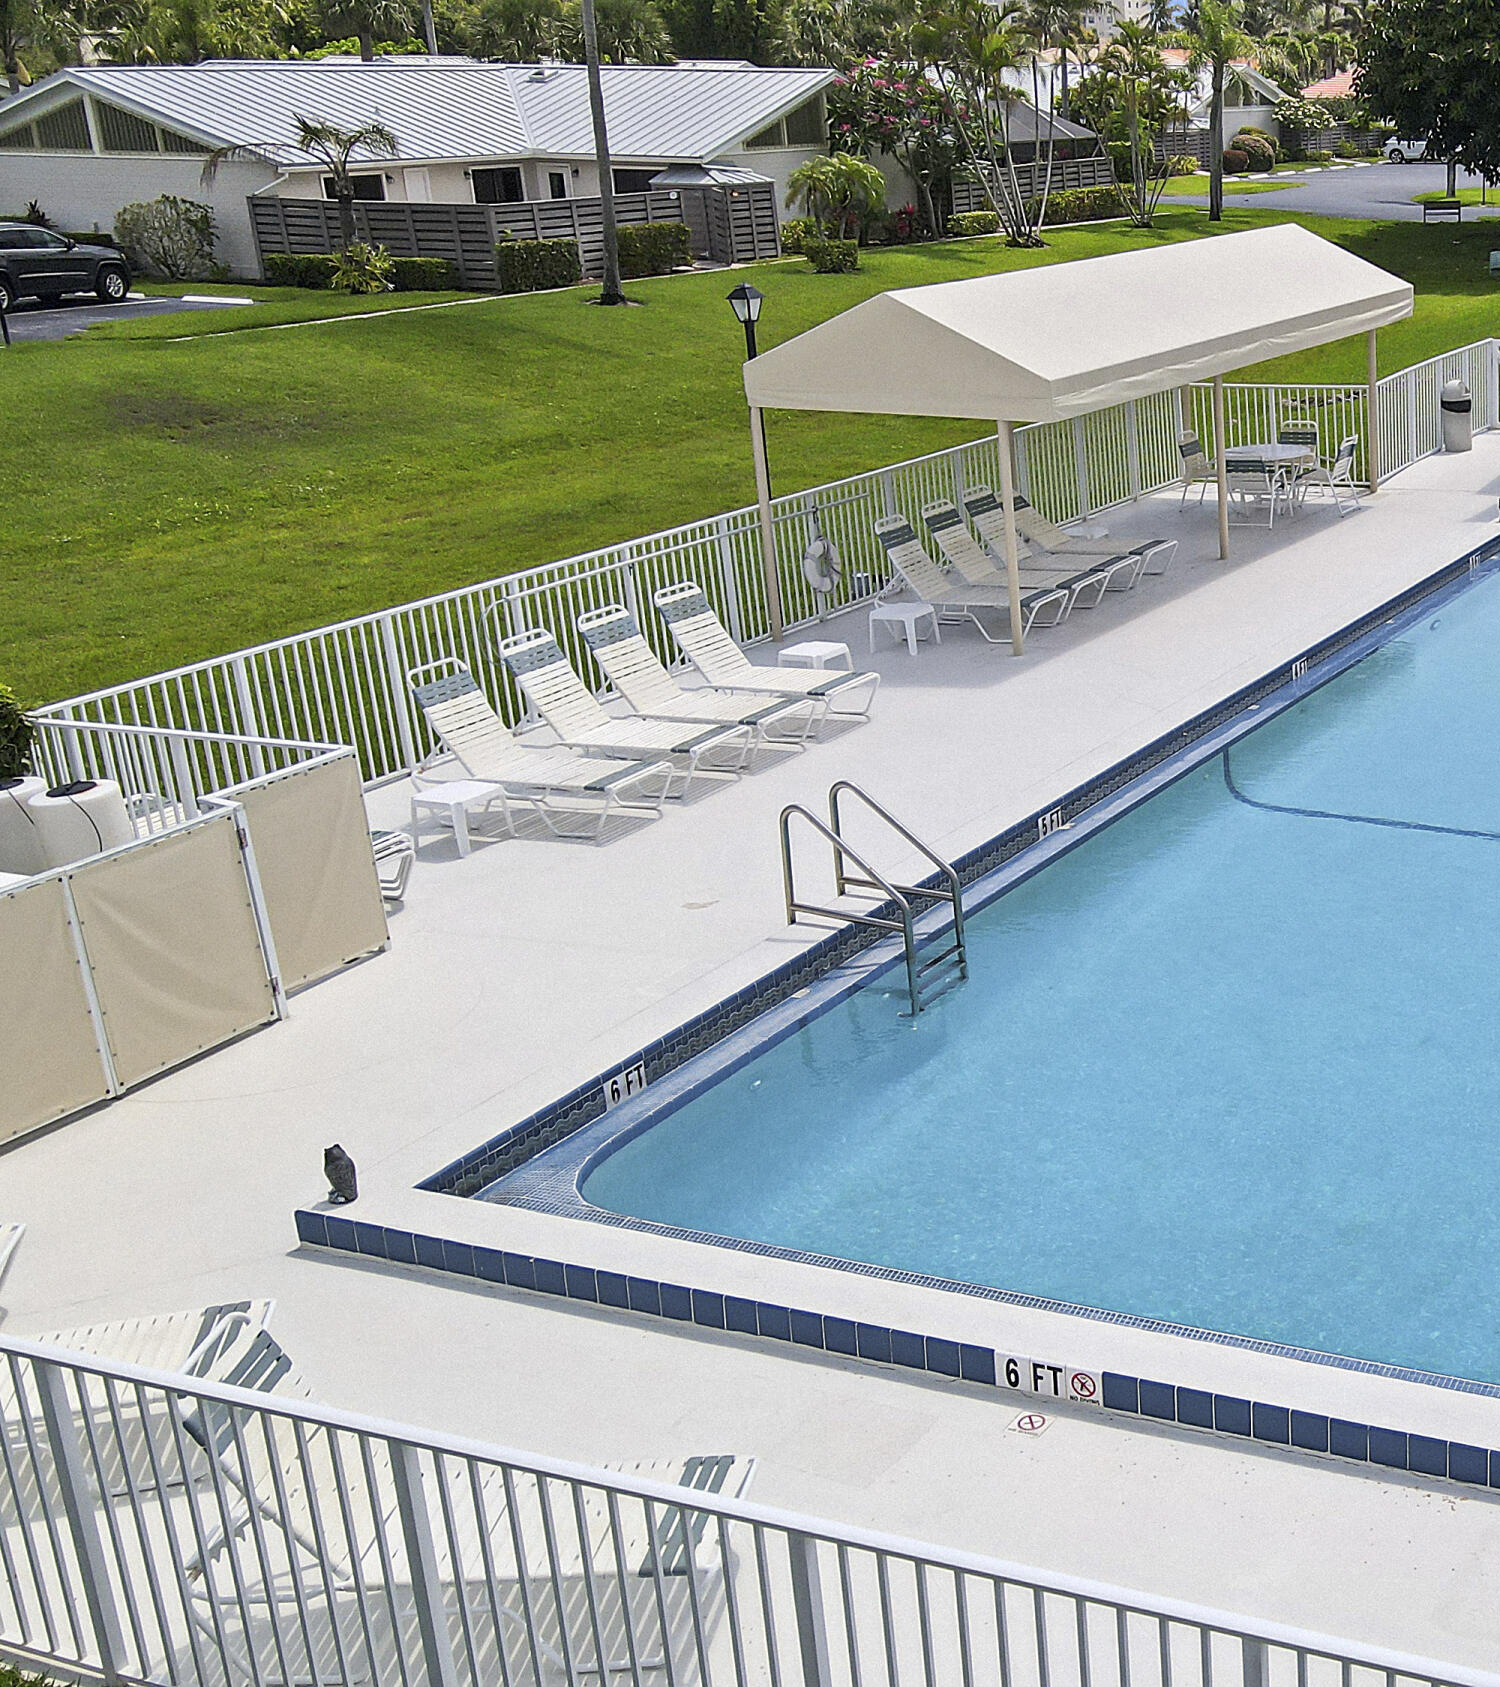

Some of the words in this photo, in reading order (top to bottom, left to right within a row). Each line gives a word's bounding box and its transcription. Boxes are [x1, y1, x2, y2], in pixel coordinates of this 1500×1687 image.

[1041, 816, 1048, 836] 5
[1050, 809, 1060, 832] FT
[610, 1079, 620, 1104] 6
[625, 1063, 643, 1096] FT
[1005, 1358, 1020, 1388] 6
[1032, 1362, 1063, 1396] FT
